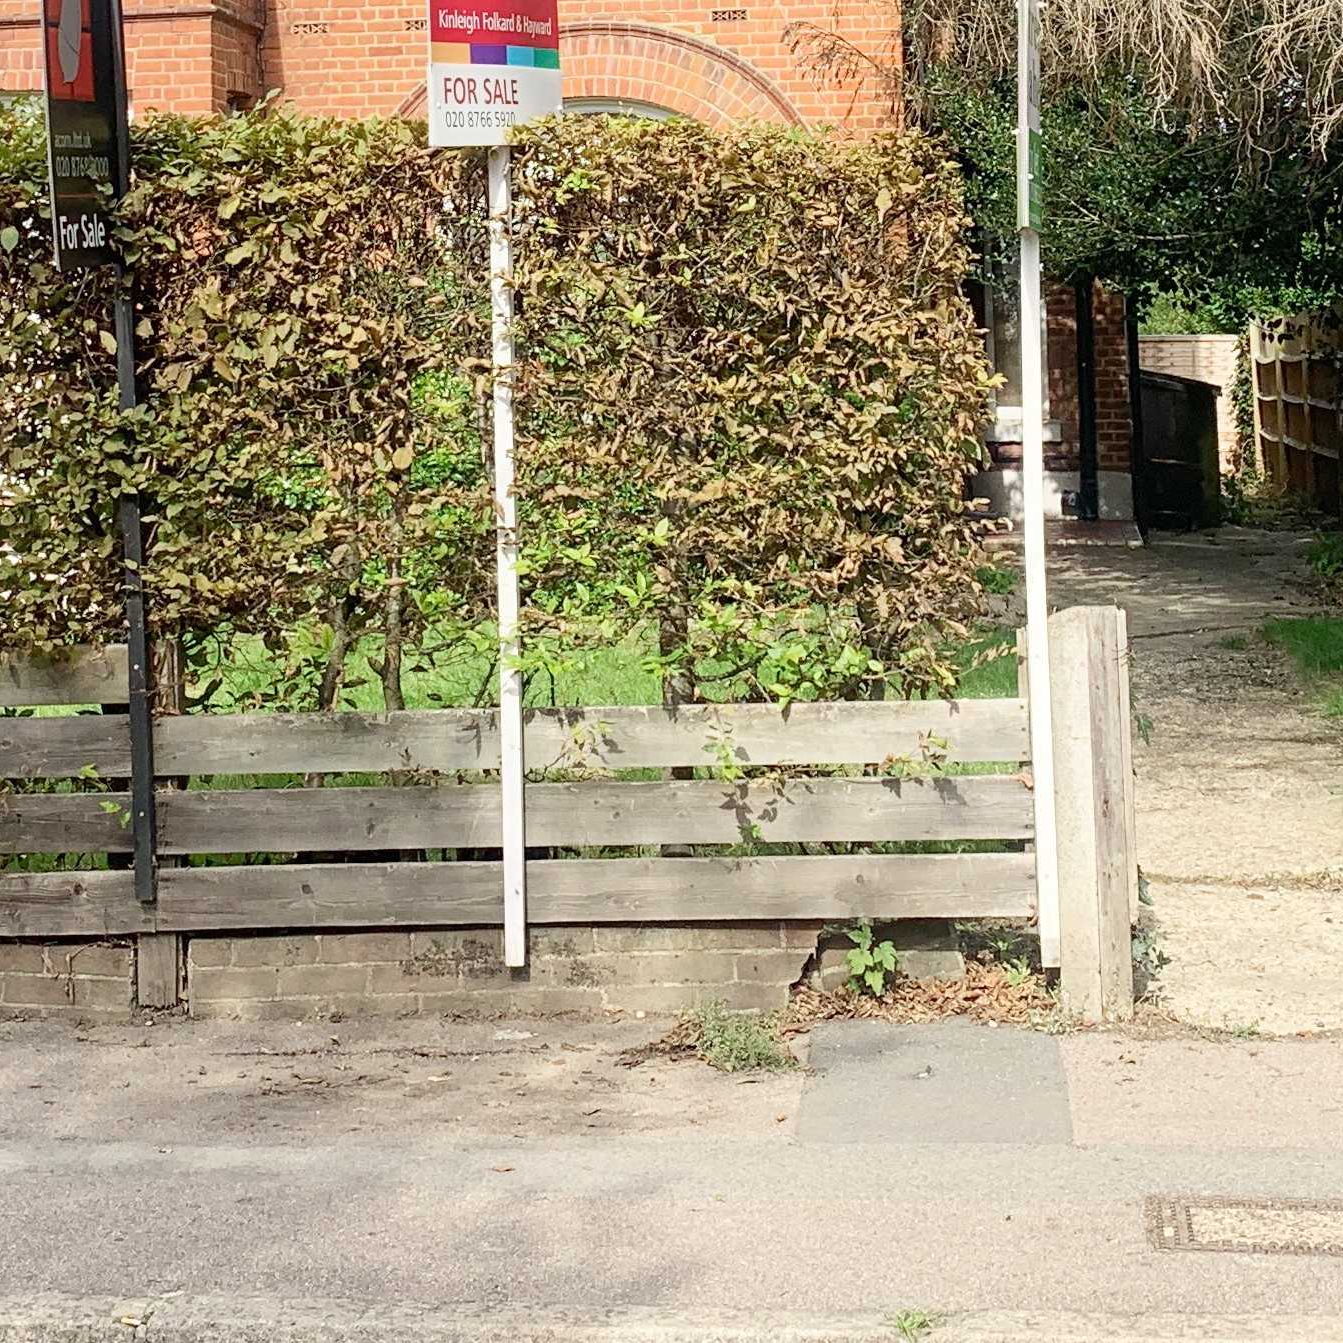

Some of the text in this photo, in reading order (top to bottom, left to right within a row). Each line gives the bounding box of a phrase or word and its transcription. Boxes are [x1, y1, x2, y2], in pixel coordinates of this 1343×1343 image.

[438, 9, 552, 38] Kinleigh Folkard & Hayward
[443, 77, 519, 105] FOR SALE
[445, 111, 465, 128] 020
[467, 111, 492, 128] 8766
[55, 156, 70, 176] 020
[59, 213, 106, 250] For Sale
